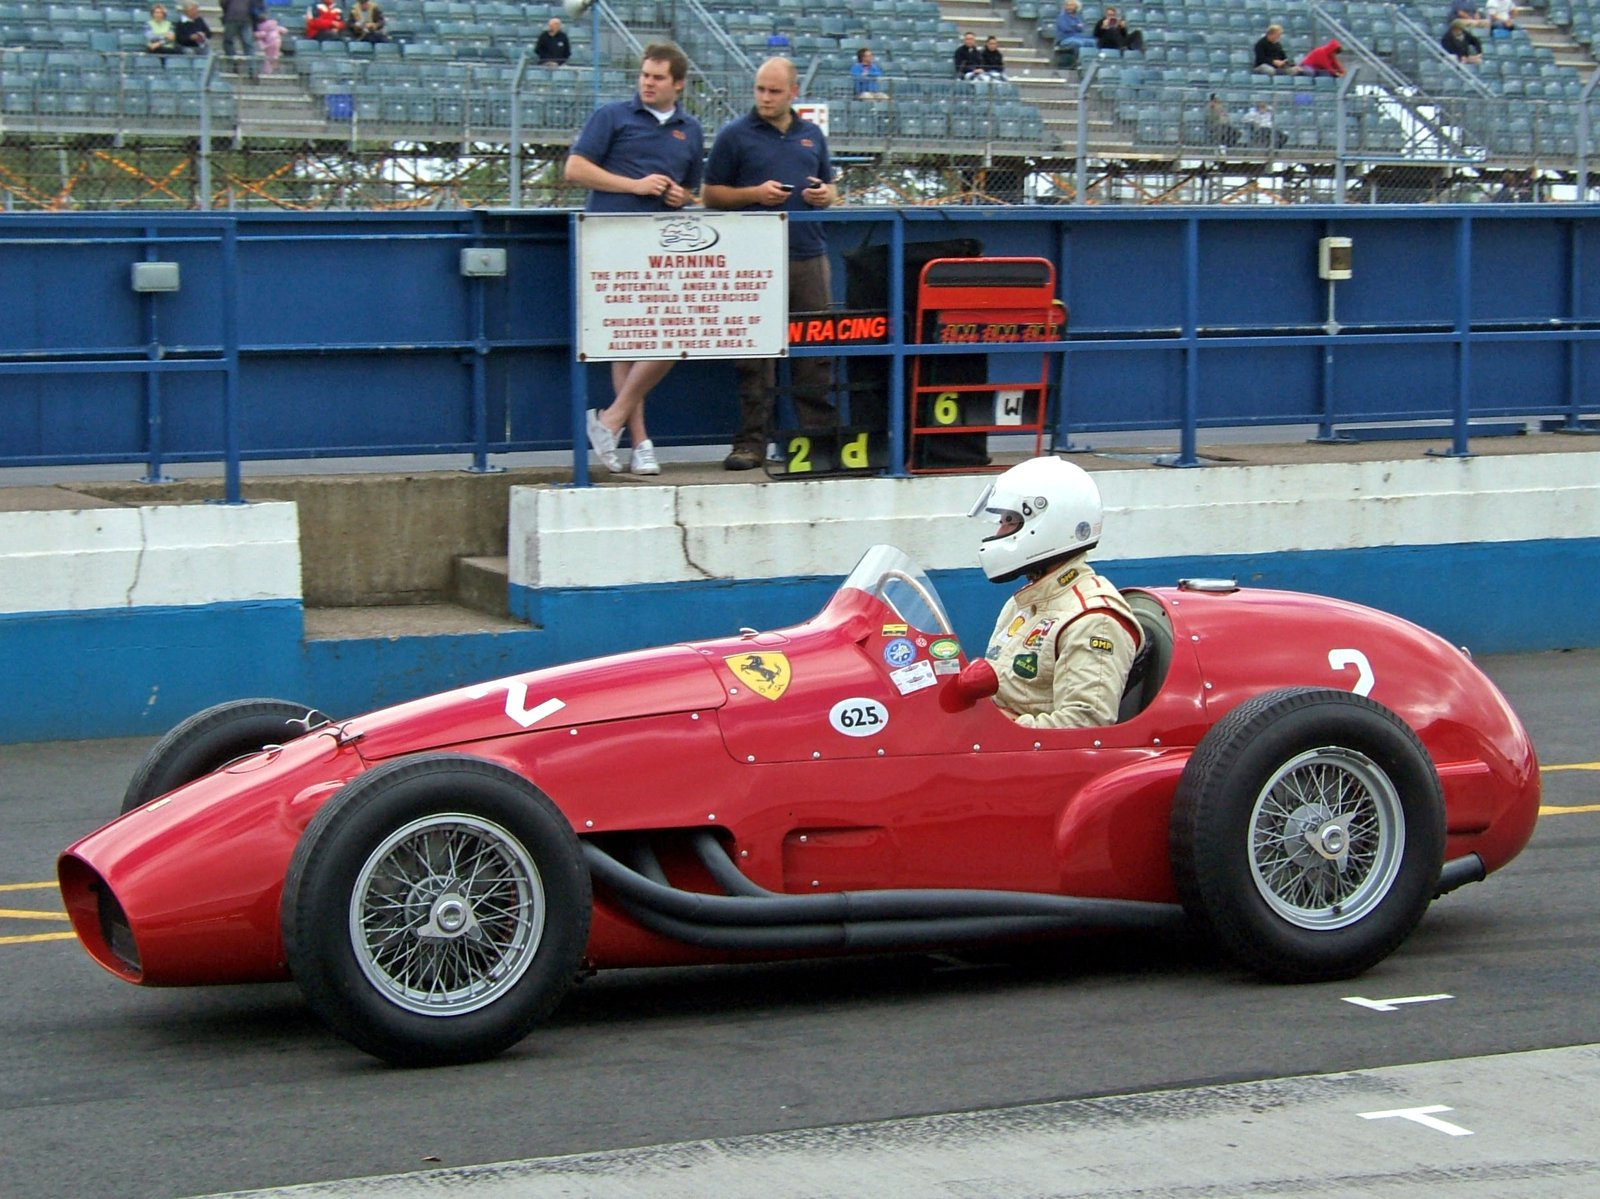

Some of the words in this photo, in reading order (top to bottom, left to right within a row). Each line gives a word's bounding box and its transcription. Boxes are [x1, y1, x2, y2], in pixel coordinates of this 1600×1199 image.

[648, 255, 726, 268] WARNING
[591, 271, 610, 280] THE
[616, 271, 639, 280] PITS
[644, 271, 652, 280] &
[657, 271, 674, 280] PIT
[678, 271, 705, 279] LANE
[711, 270, 730, 279] ARE
[595, 283, 607, 292] OF
[613, 282, 670, 291] POTENTIAL
[721, 282, 729, 290] &
[734, 281, 768, 290] GREAT
[604, 294, 633, 303] CARE
[638, 294, 679, 303] SHOULD
[684, 294, 697, 302] BE
[701, 293, 759, 302] EXERCISED
[646, 305, 659, 314] AT
[664, 305, 683, 314] ALL
[688, 305, 720, 313] TIMES
[603, 318, 655, 327] CHILDREN
[660, 317, 695, 326] UNDER
[699, 316, 719, 325] THE
[724, 316, 744, 325] AGE
[748, 315, 762, 324] OF
[613, 329, 658, 338] SIXTEEN
[663, 329, 697, 337] YEARS
[702, 328, 722, 336] ARE
[727, 327, 748, 336] NOT
[806, 316, 887, 341] RACING
[608, 341, 657, 350] ALLOWED
[662, 340, 673, 349] IN
[678, 340, 711, 348] THESE
[788, 436, 812, 473] 2
[1091, 639, 1112, 651] OMP
